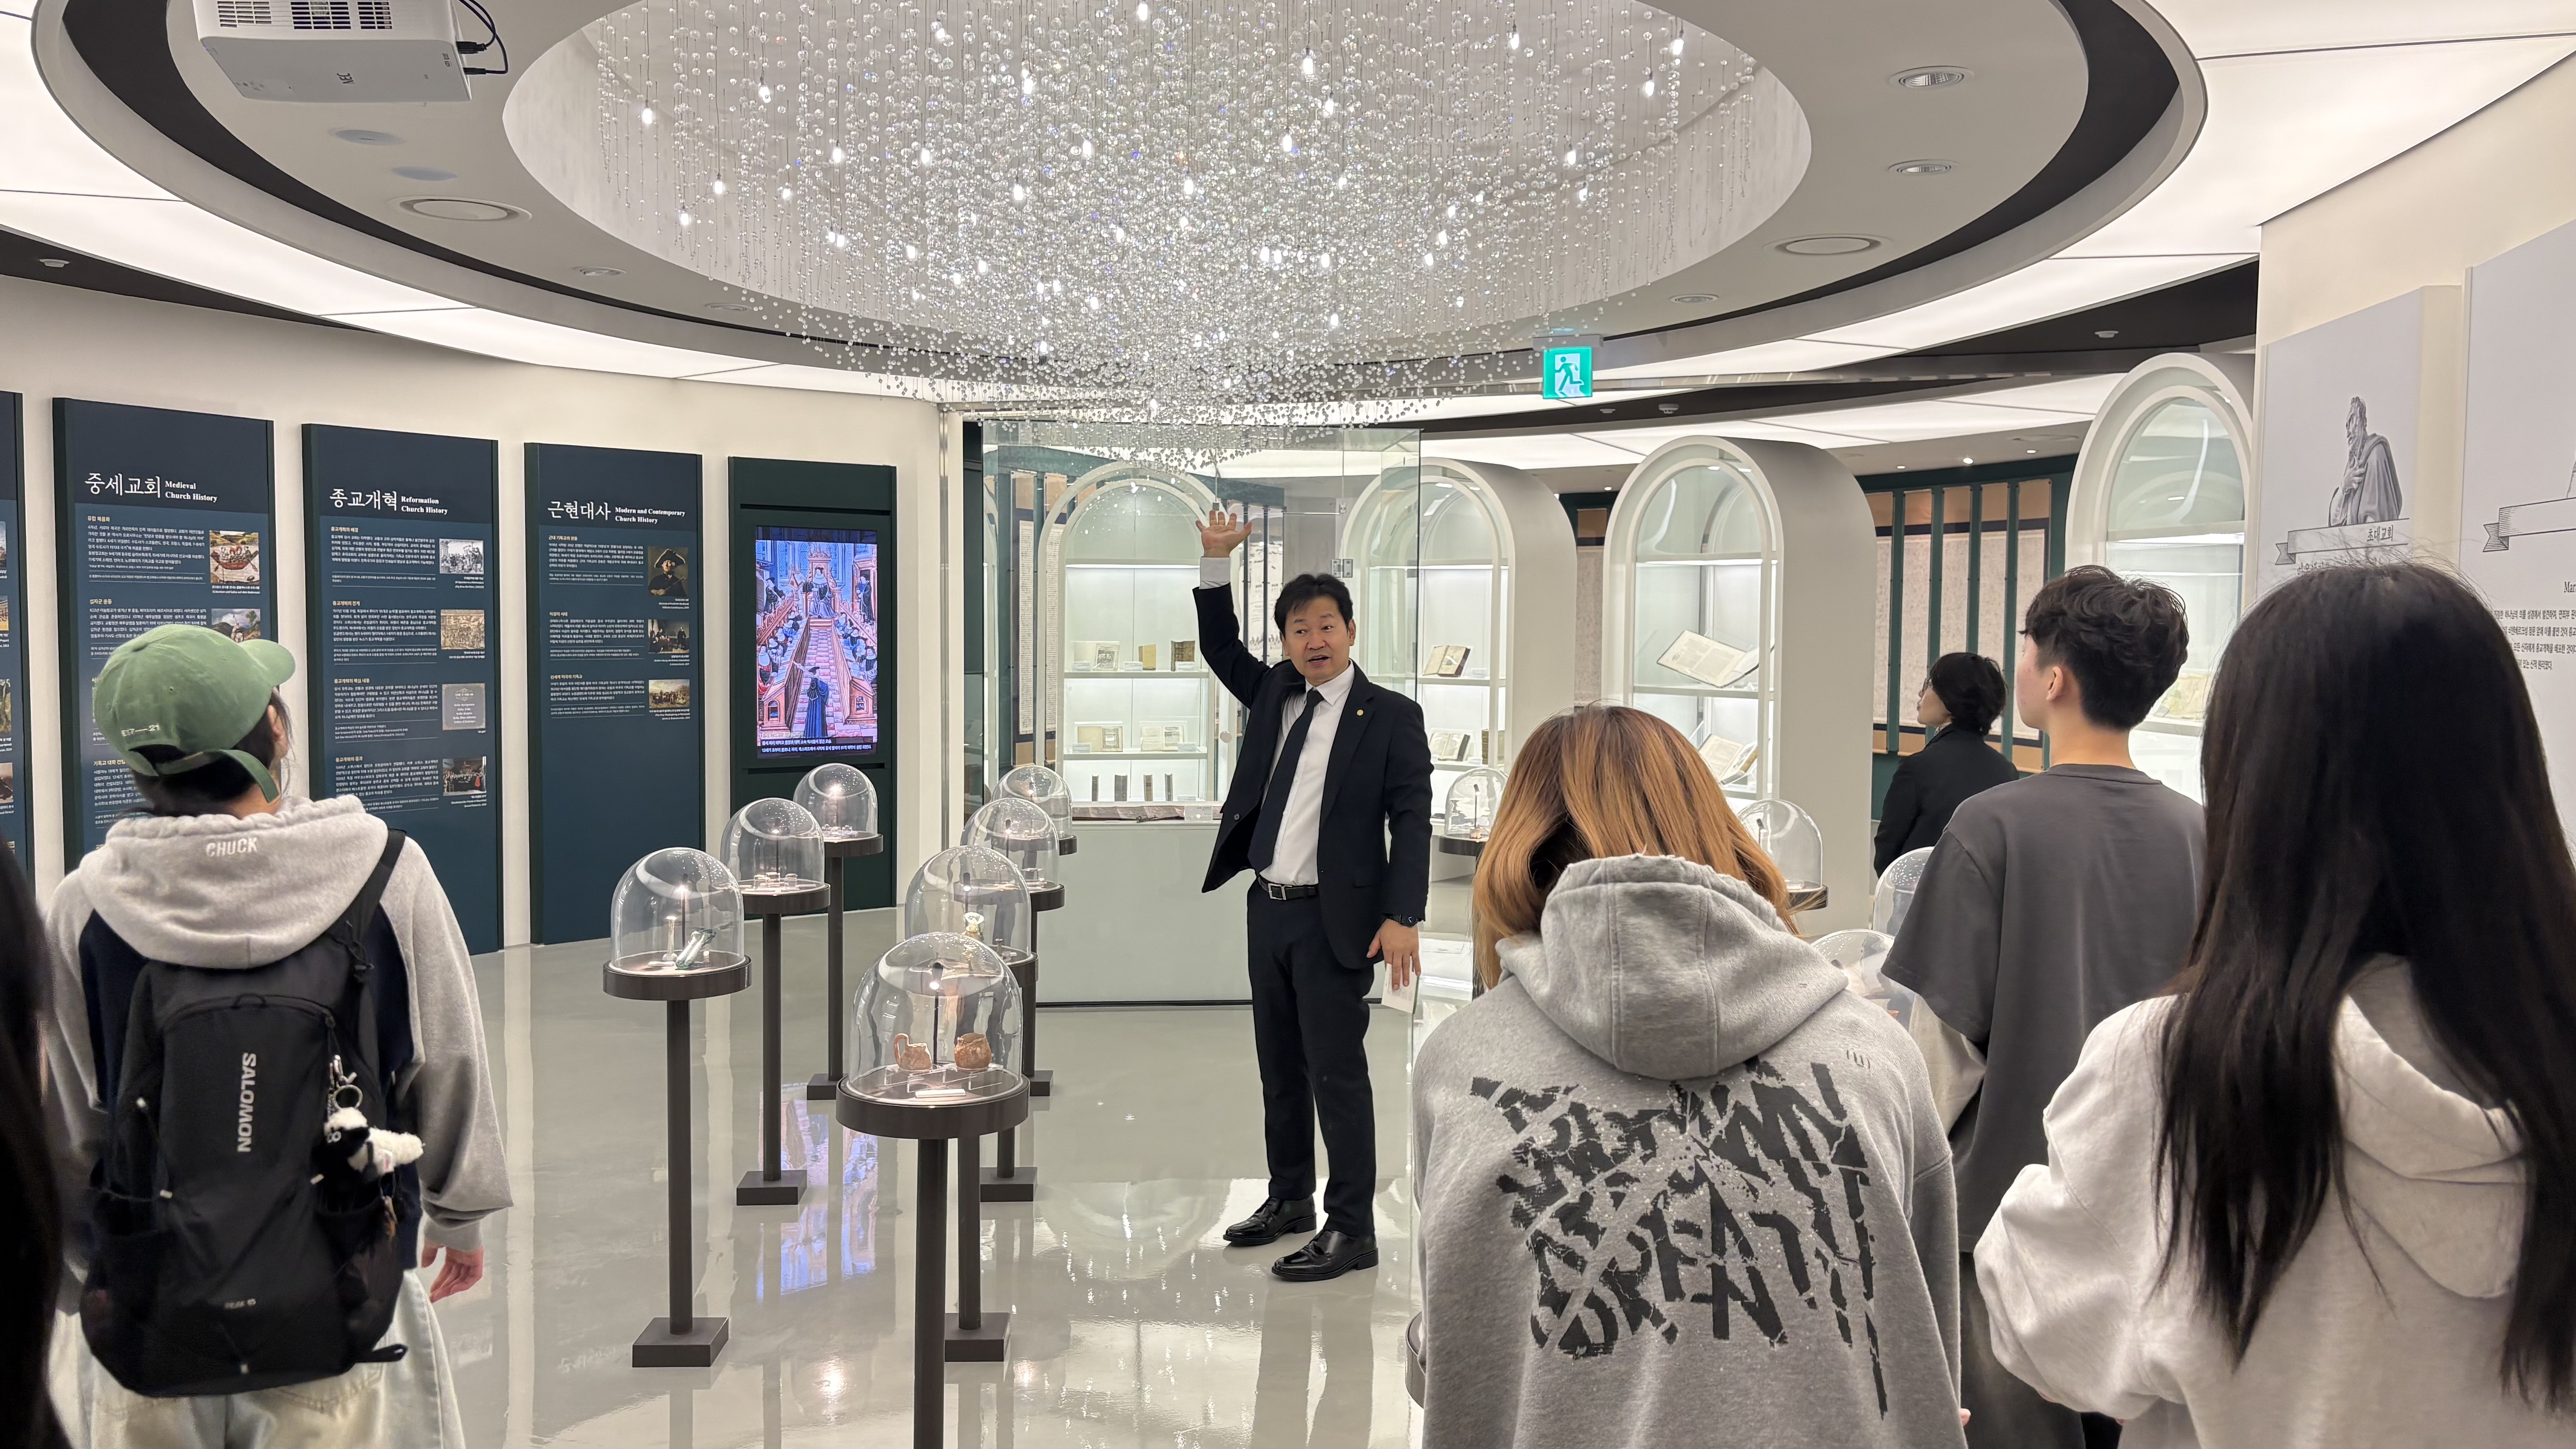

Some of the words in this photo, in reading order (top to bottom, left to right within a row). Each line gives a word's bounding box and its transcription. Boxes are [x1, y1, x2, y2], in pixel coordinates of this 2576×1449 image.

[85, 473, 161, 498] 중세교회
[165, 481, 196, 490] Medieval
[165, 491, 191, 500] Church
[193, 493, 217, 503] History
[329, 488, 397, 511] 종교개혁
[401, 496, 439, 505] Reformation
[425, 507, 448, 515] History
[547, 501, 611, 521] 근현대사
[649, 509, 685, 517] Contemporary
[2367, 524, 2393, 543] 초대교회
[206, 837, 258, 857] CHUCK
[237, 1052, 257, 1153] SALOMON
